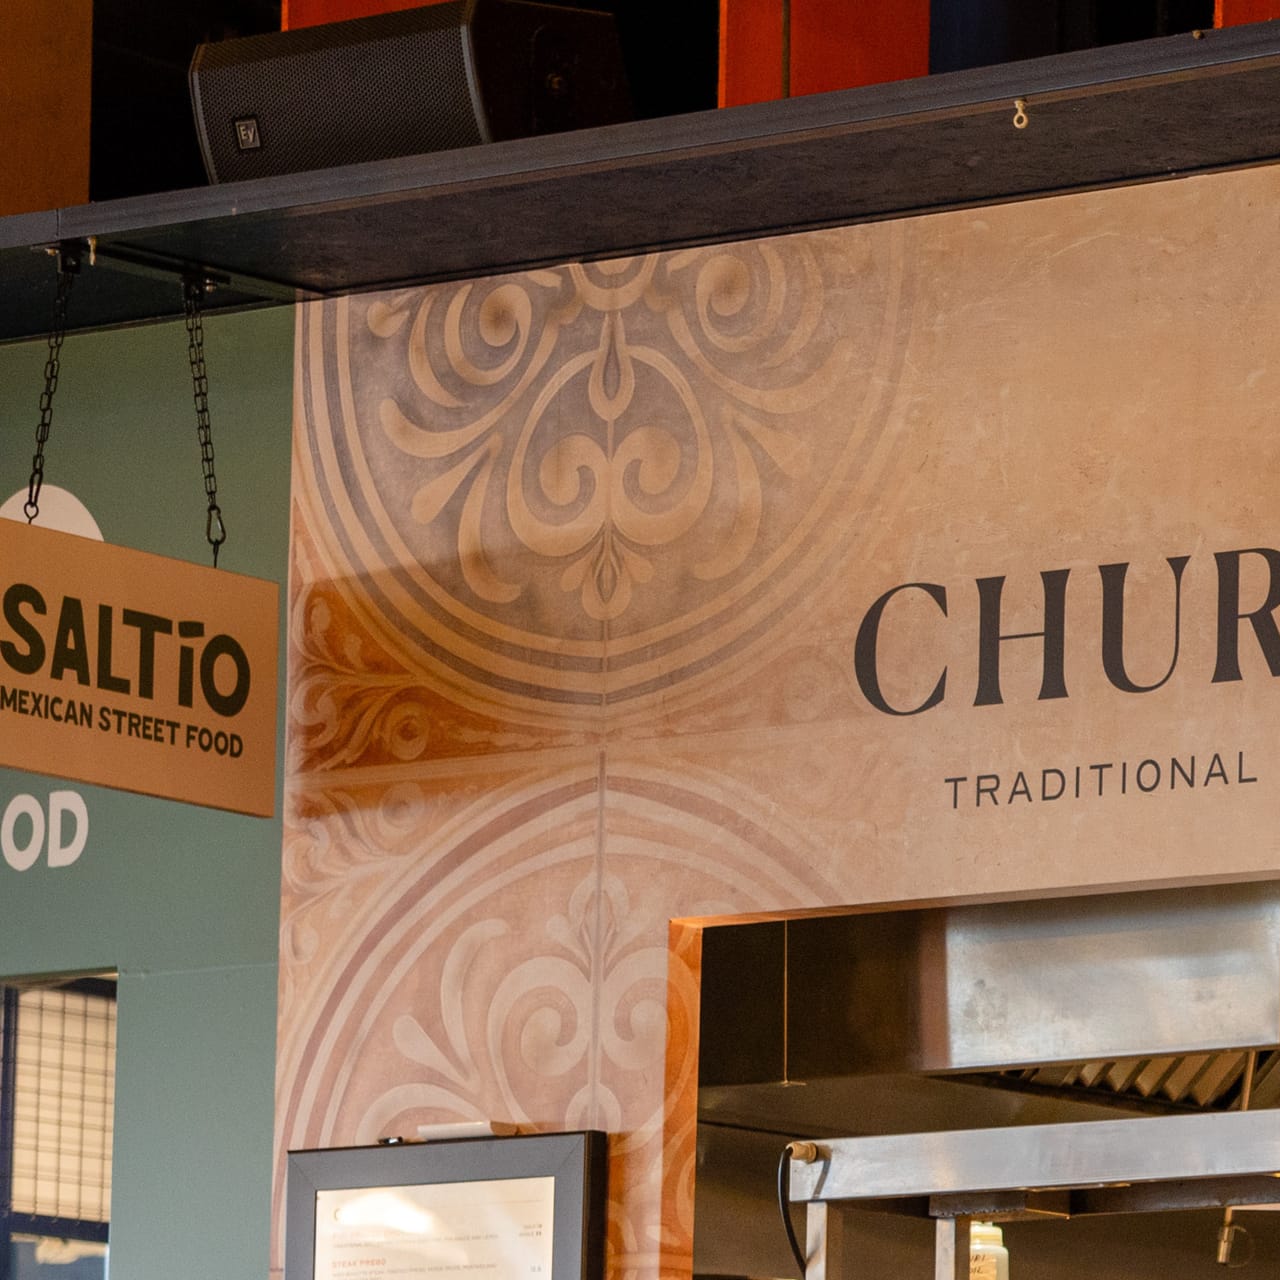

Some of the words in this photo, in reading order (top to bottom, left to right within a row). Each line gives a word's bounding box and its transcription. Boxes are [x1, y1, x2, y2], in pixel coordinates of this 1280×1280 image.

[0, 685, 94, 729] MEXICAN
[98, 706, 181, 747] STREET
[185, 724, 244, 759] FOOD
[944, 750, 1258, 810] TRADITIONAL
